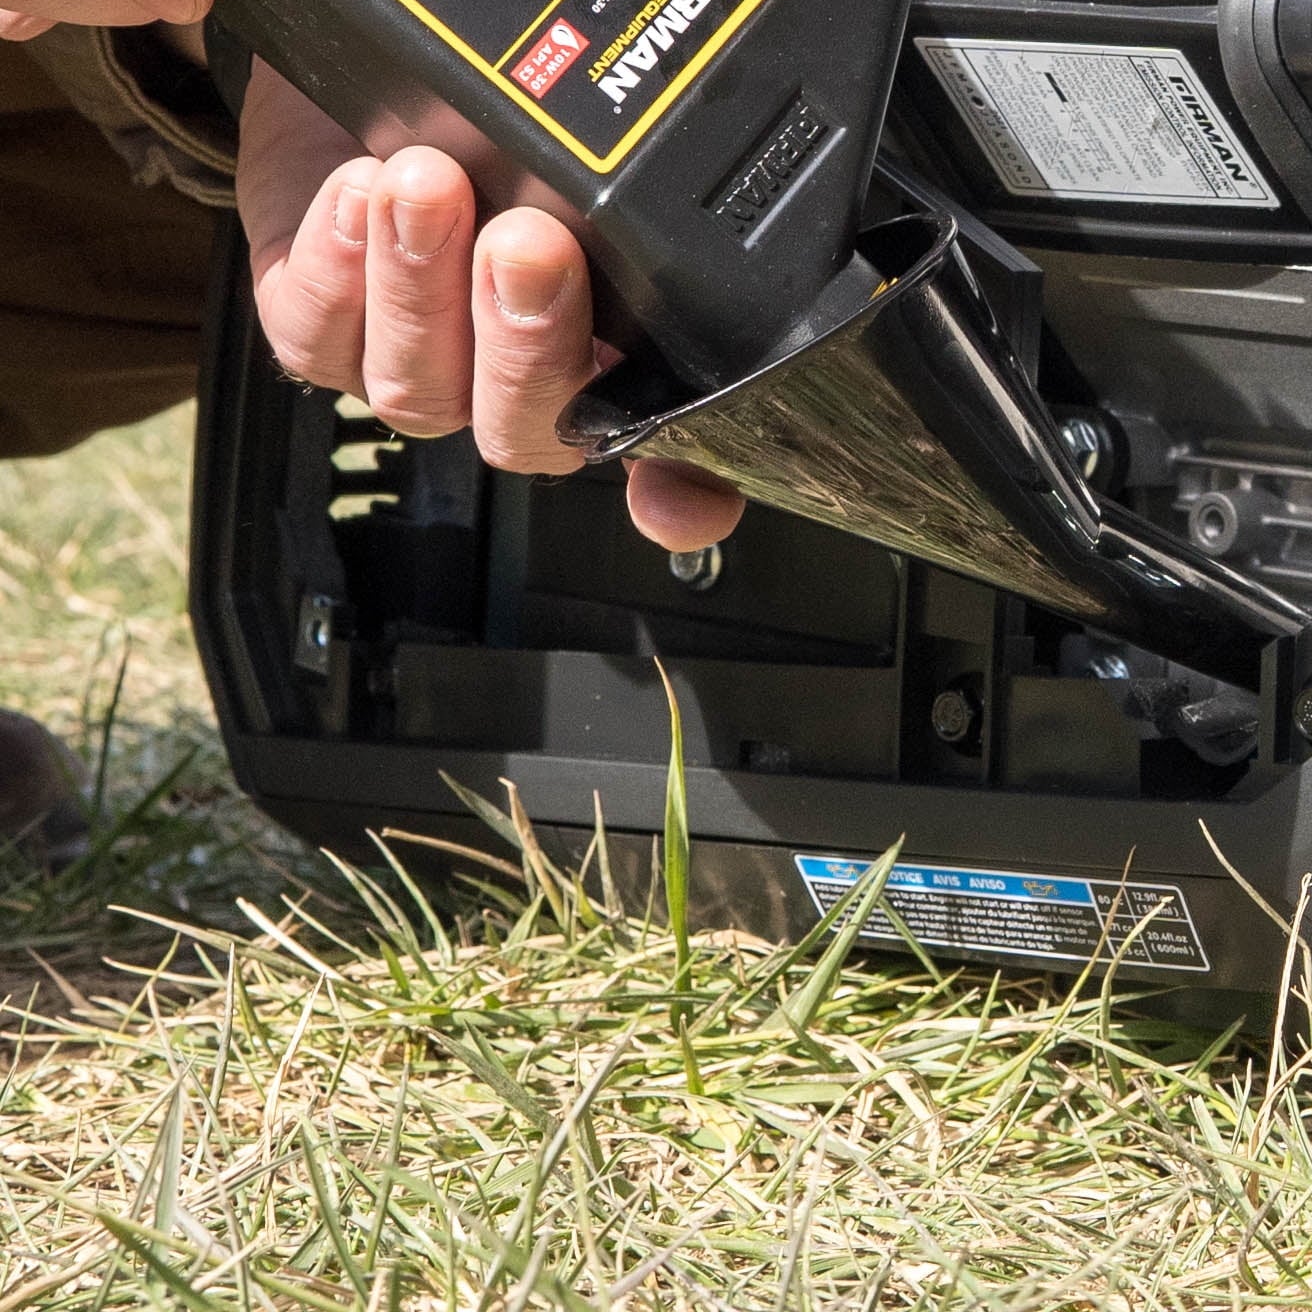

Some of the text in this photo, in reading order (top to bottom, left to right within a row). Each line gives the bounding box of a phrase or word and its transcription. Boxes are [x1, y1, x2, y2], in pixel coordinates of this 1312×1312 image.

[518, 42, 552, 81] API SJ
[529, 48, 570, 90] 10W-30
[1167, 76, 1249, 181] FIRMAN
[886, 870, 1007, 890] OTICE AVIS AVISO
